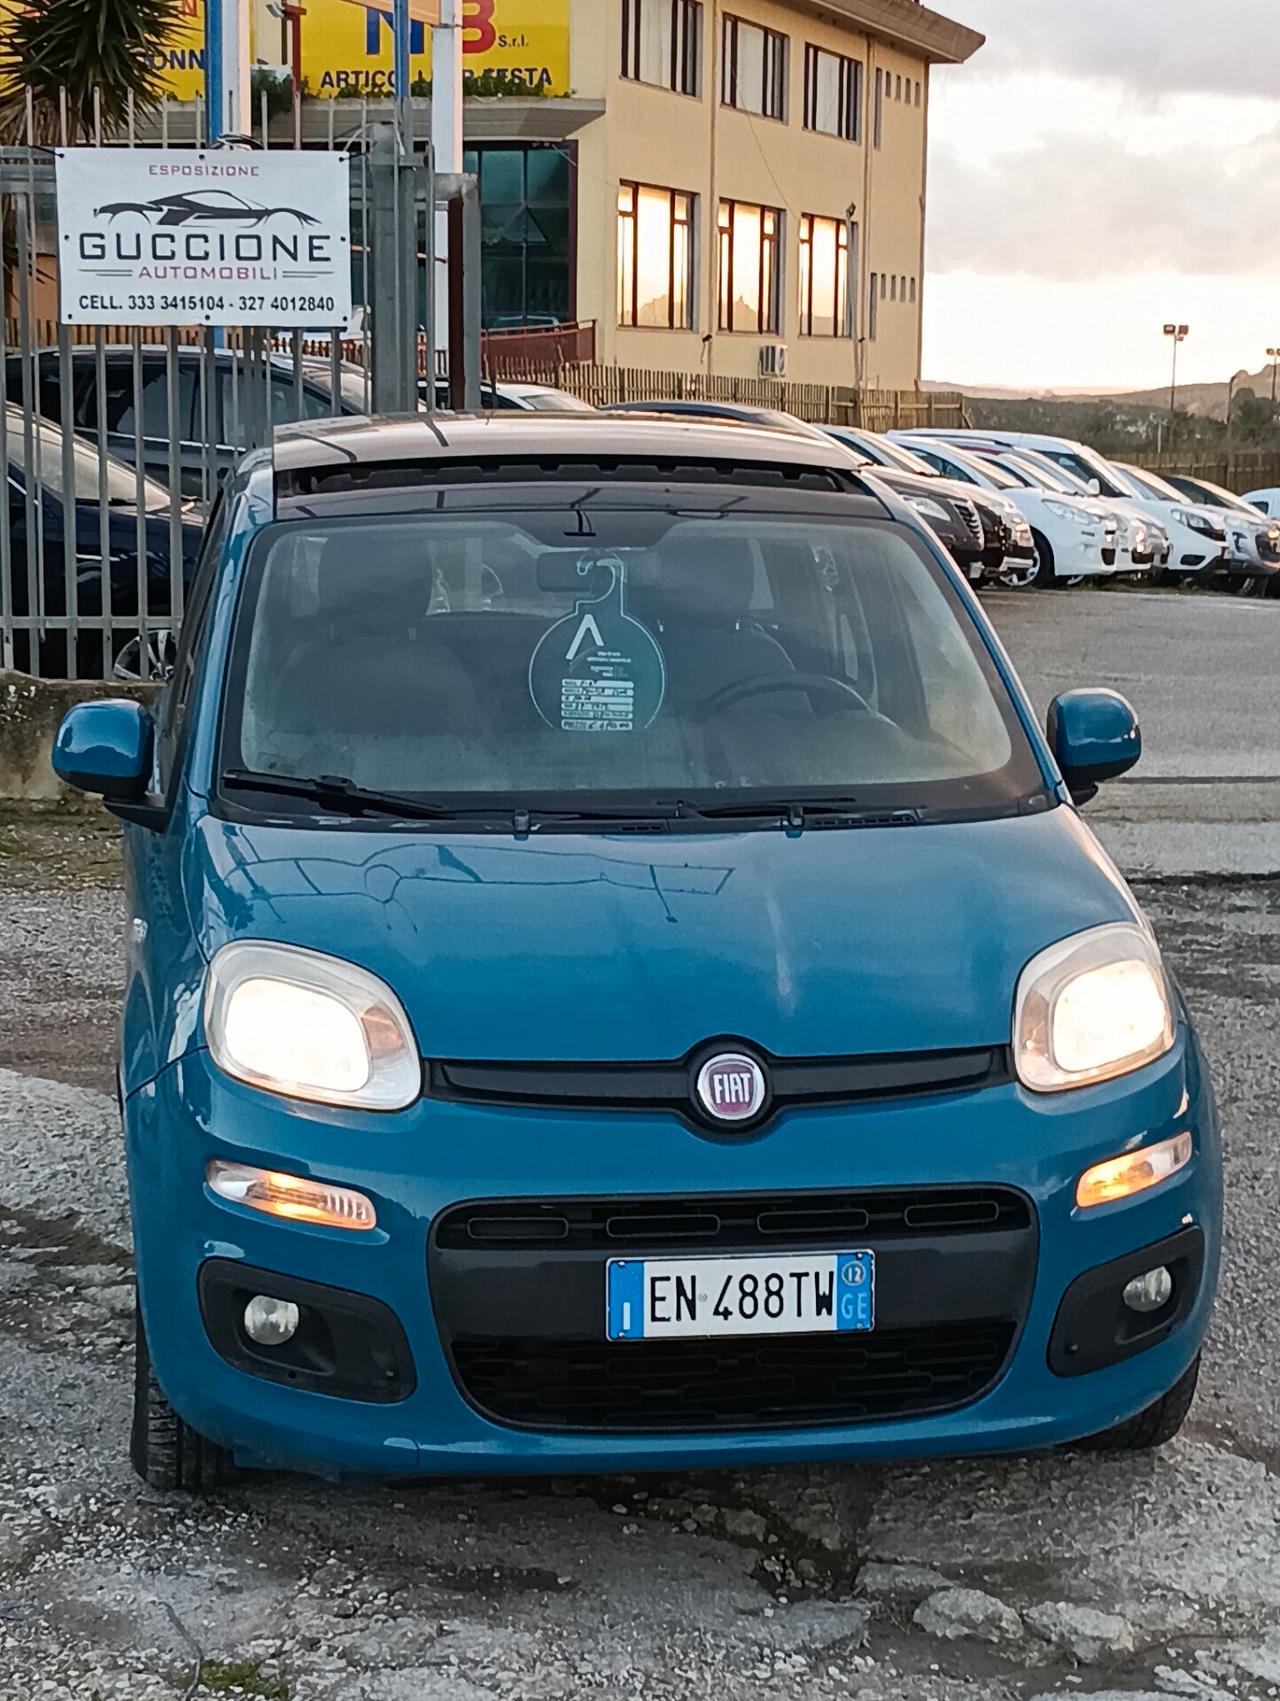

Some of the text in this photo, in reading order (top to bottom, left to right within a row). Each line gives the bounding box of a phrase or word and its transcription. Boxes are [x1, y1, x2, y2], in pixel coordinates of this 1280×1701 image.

[148, 164, 260, 177] ESPOSIZIONE
[79, 232, 332, 262] GUCCIONE
[138, 266, 278, 280] AUTOMOBILI
[79, 295, 122, 310] CELL.
[128, 295, 155, 310] 333
[160, 296, 225, 311] 3415104
[239, 296, 265, 311] 327
[271, 296, 335, 312] 4012840
[713, 1072, 752, 1105] FIAT
[650, 1275, 698, 1323] EN
[713, 1270, 834, 1321] 488TW
[840, 1292, 868, 1320] GE
